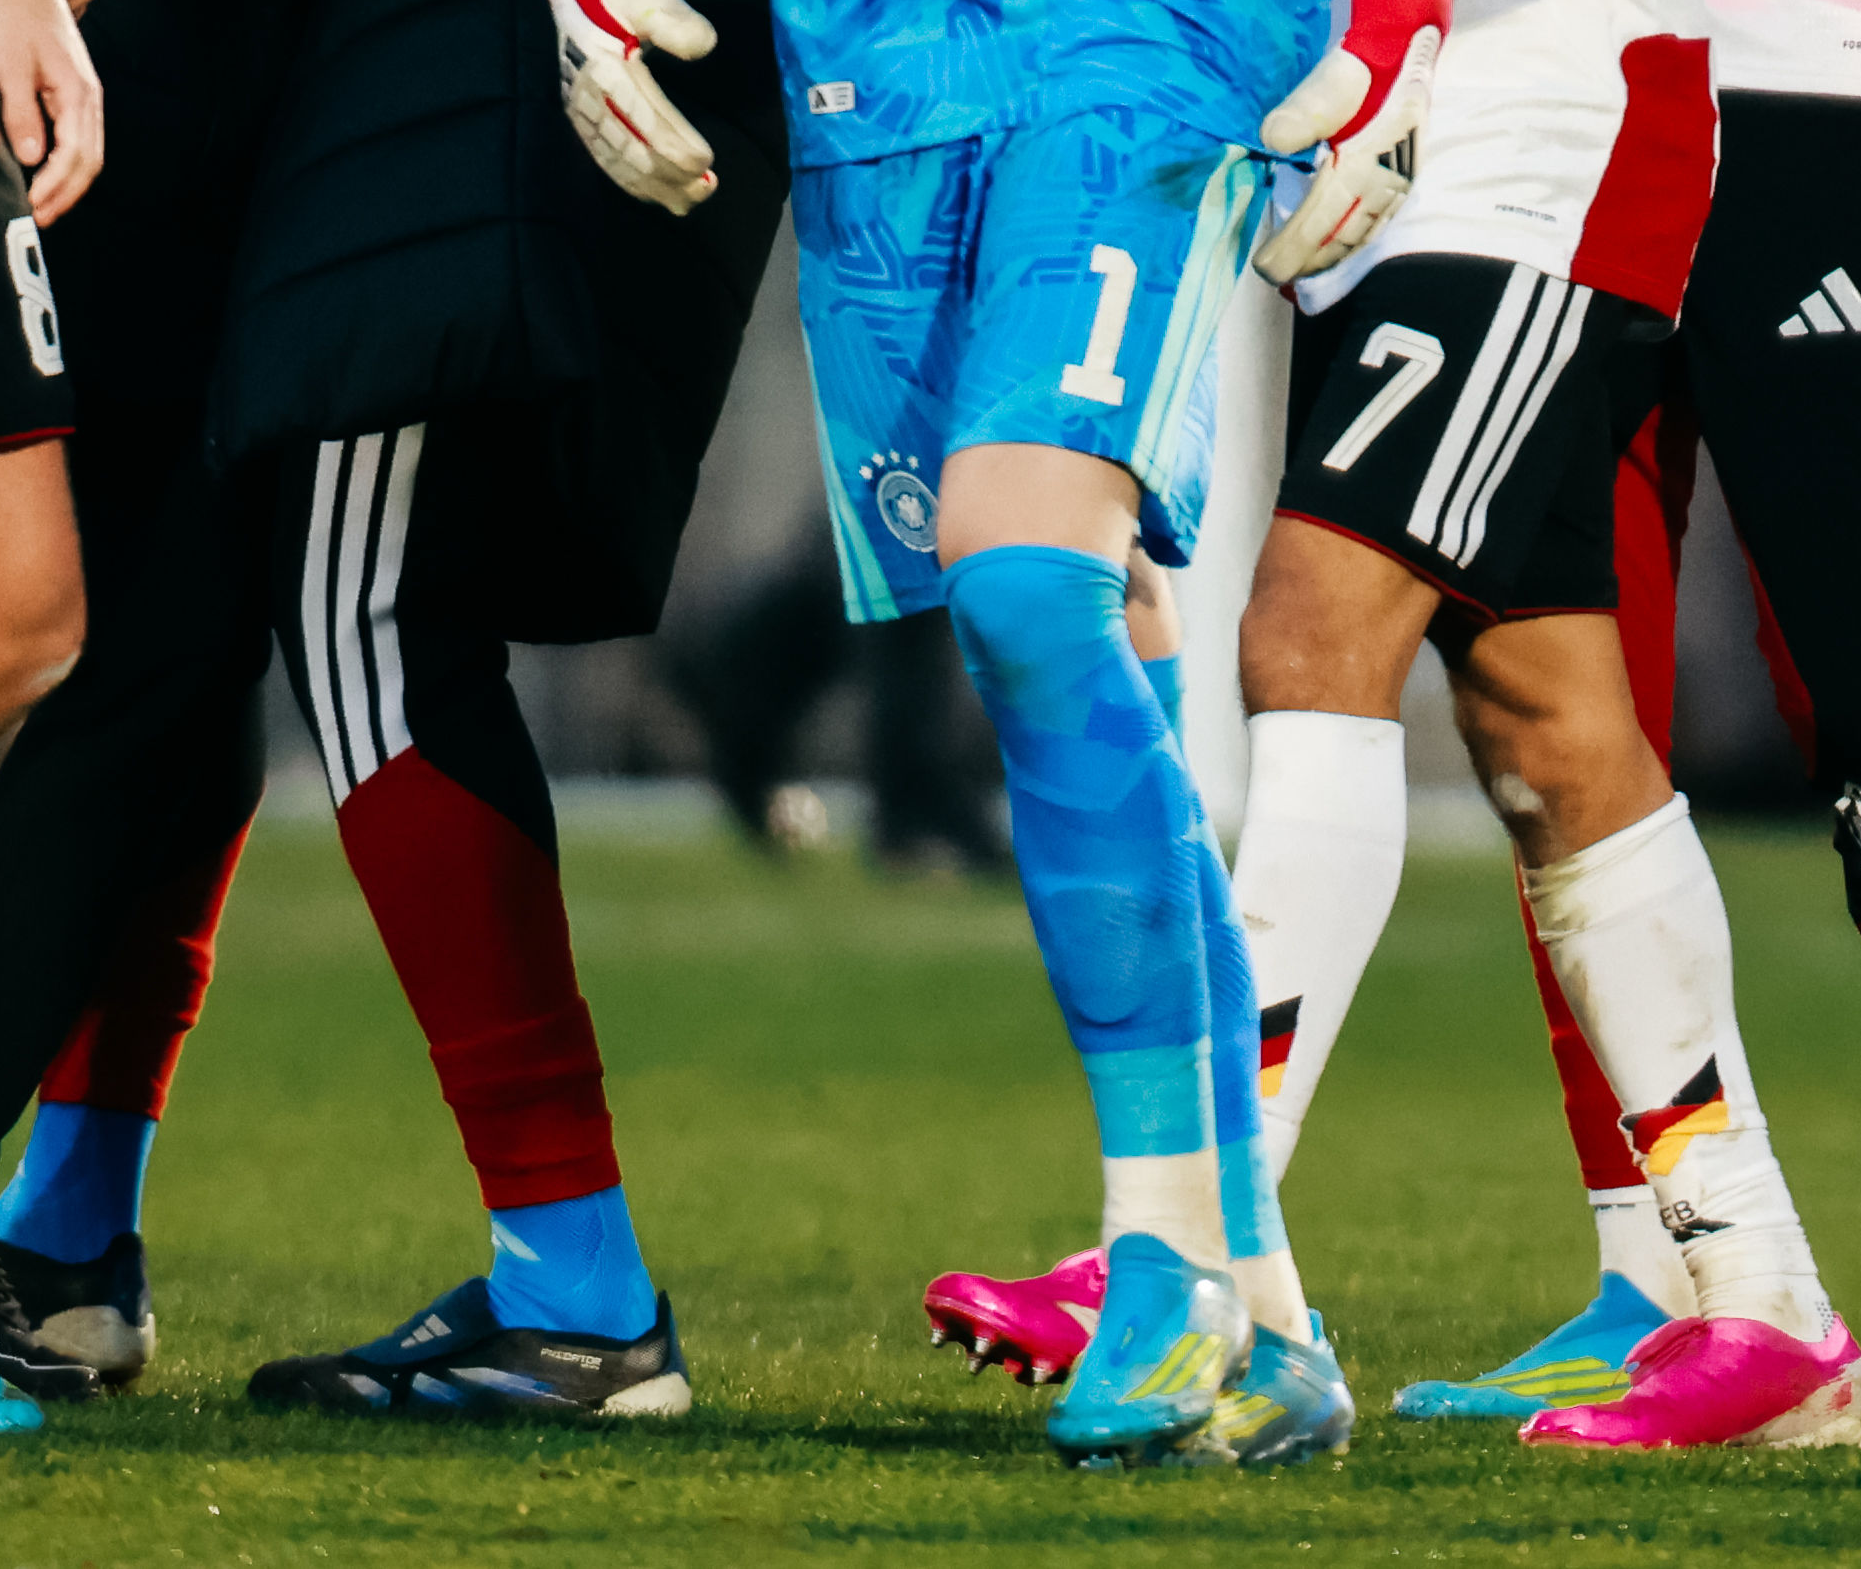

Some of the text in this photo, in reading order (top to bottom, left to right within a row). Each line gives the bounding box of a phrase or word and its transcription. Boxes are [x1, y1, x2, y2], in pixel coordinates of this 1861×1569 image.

[6, 215, 65, 377] 8
[1060, 244, 1138, 406] 1
[1321, 322, 1445, 473] 7
[1659, 1200, 1696, 1230] FB
